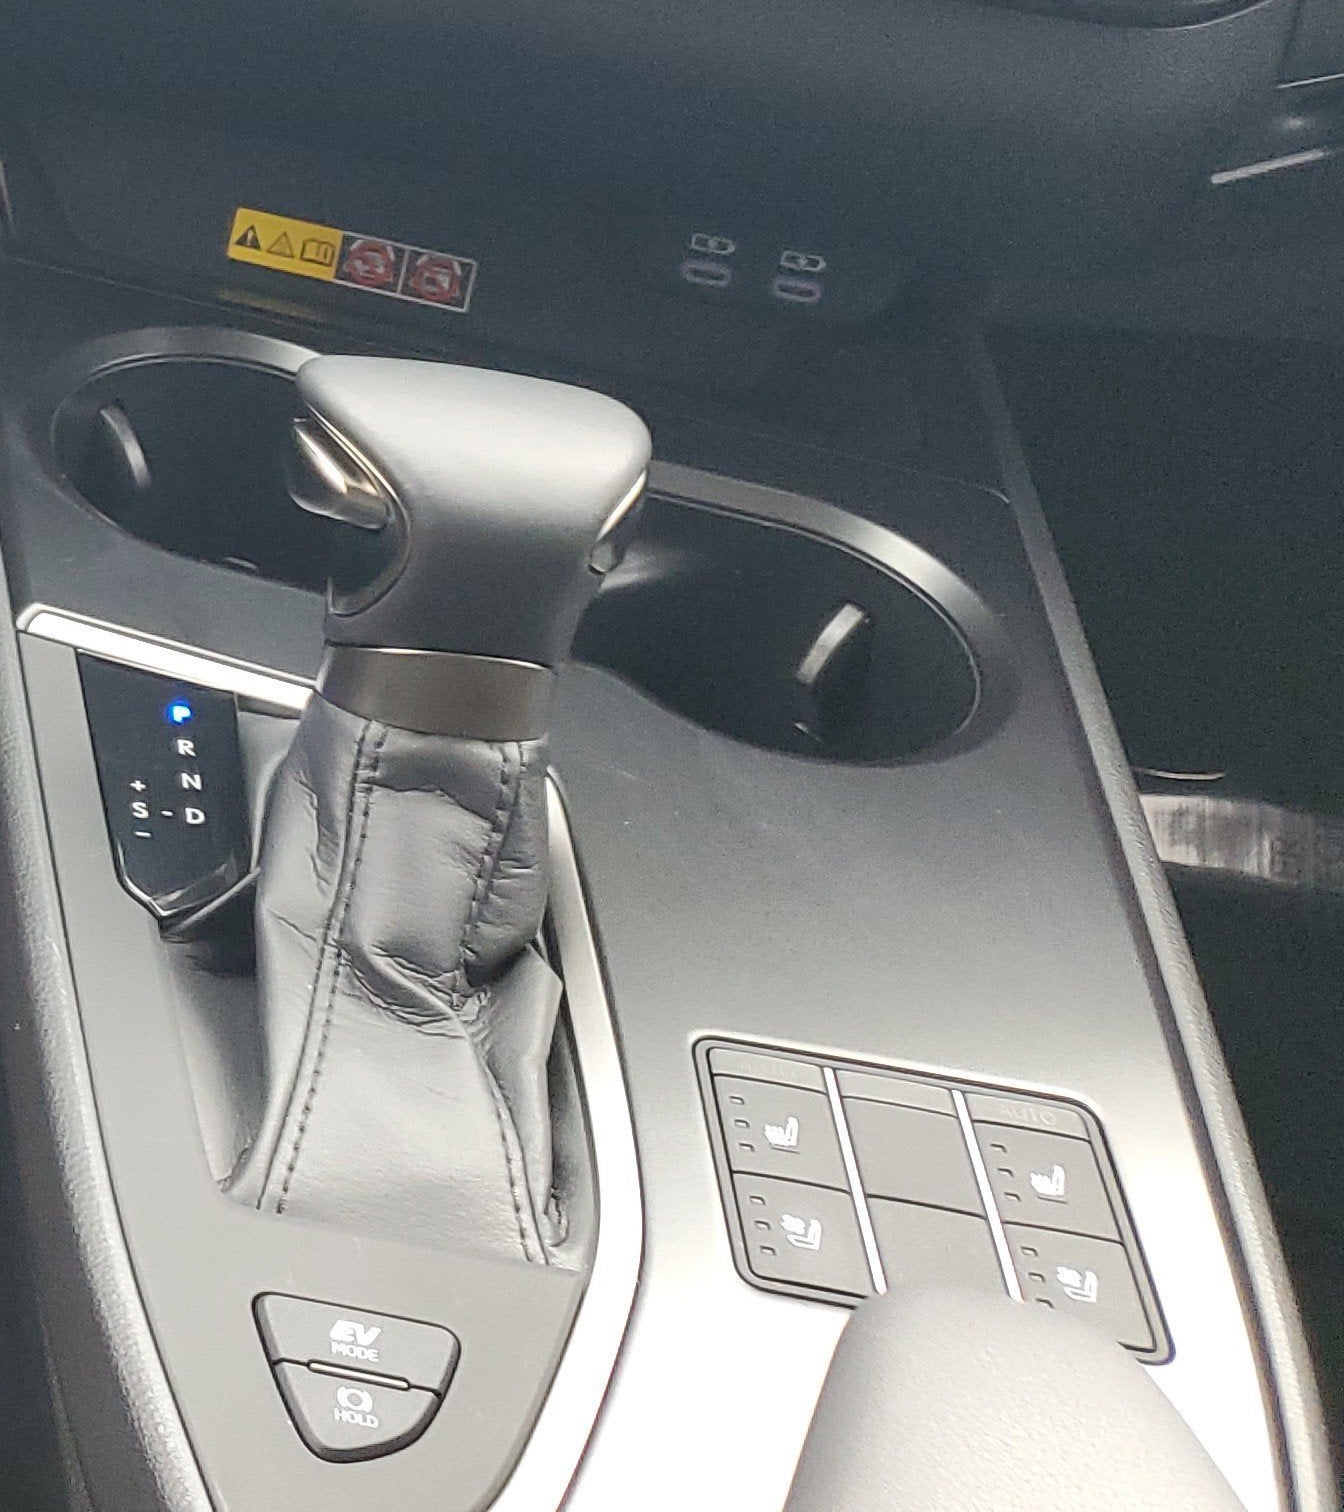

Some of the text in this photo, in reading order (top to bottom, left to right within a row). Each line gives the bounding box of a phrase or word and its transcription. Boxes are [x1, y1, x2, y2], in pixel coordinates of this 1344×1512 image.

[177, 738, 196, 757] R
[181, 772, 203, 791] N
[131, 801, 206, 826] S D
[329, 1319, 382, 1346] EV
[330, 1342, 380, 1362] MODE
[334, 1407, 379, 1429] HOLD
